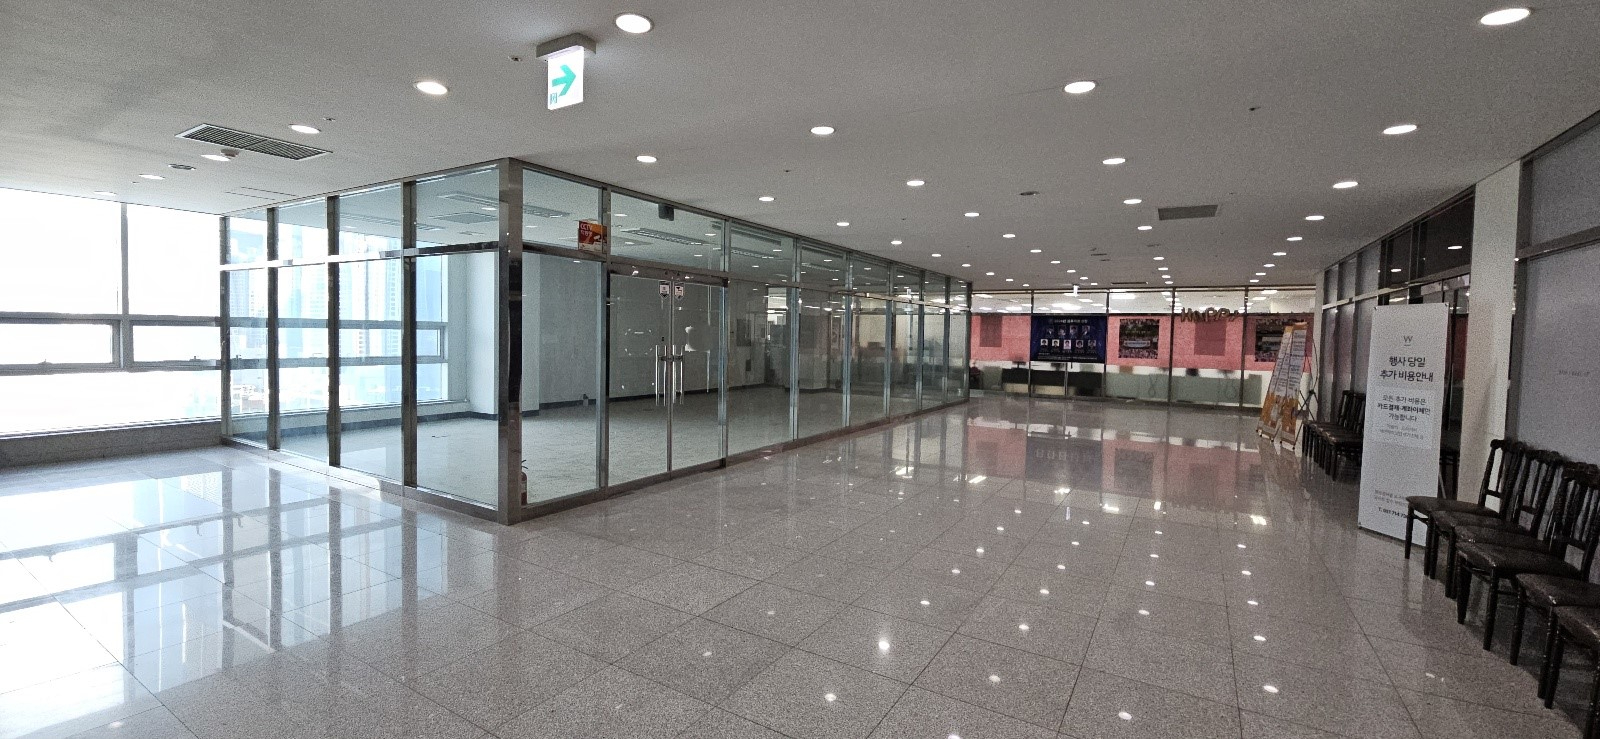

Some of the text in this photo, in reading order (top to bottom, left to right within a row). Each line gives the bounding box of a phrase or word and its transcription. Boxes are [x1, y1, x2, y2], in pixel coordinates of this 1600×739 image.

[580, 223, 592, 231] CCTV
[1389, 356, 1426, 368] 행사 당일
[1380, 369, 1434, 382] 추가 비용안내
[1408, 397, 1427, 406] 비용은
[1388, 412, 1418, 422] 가능합니다
